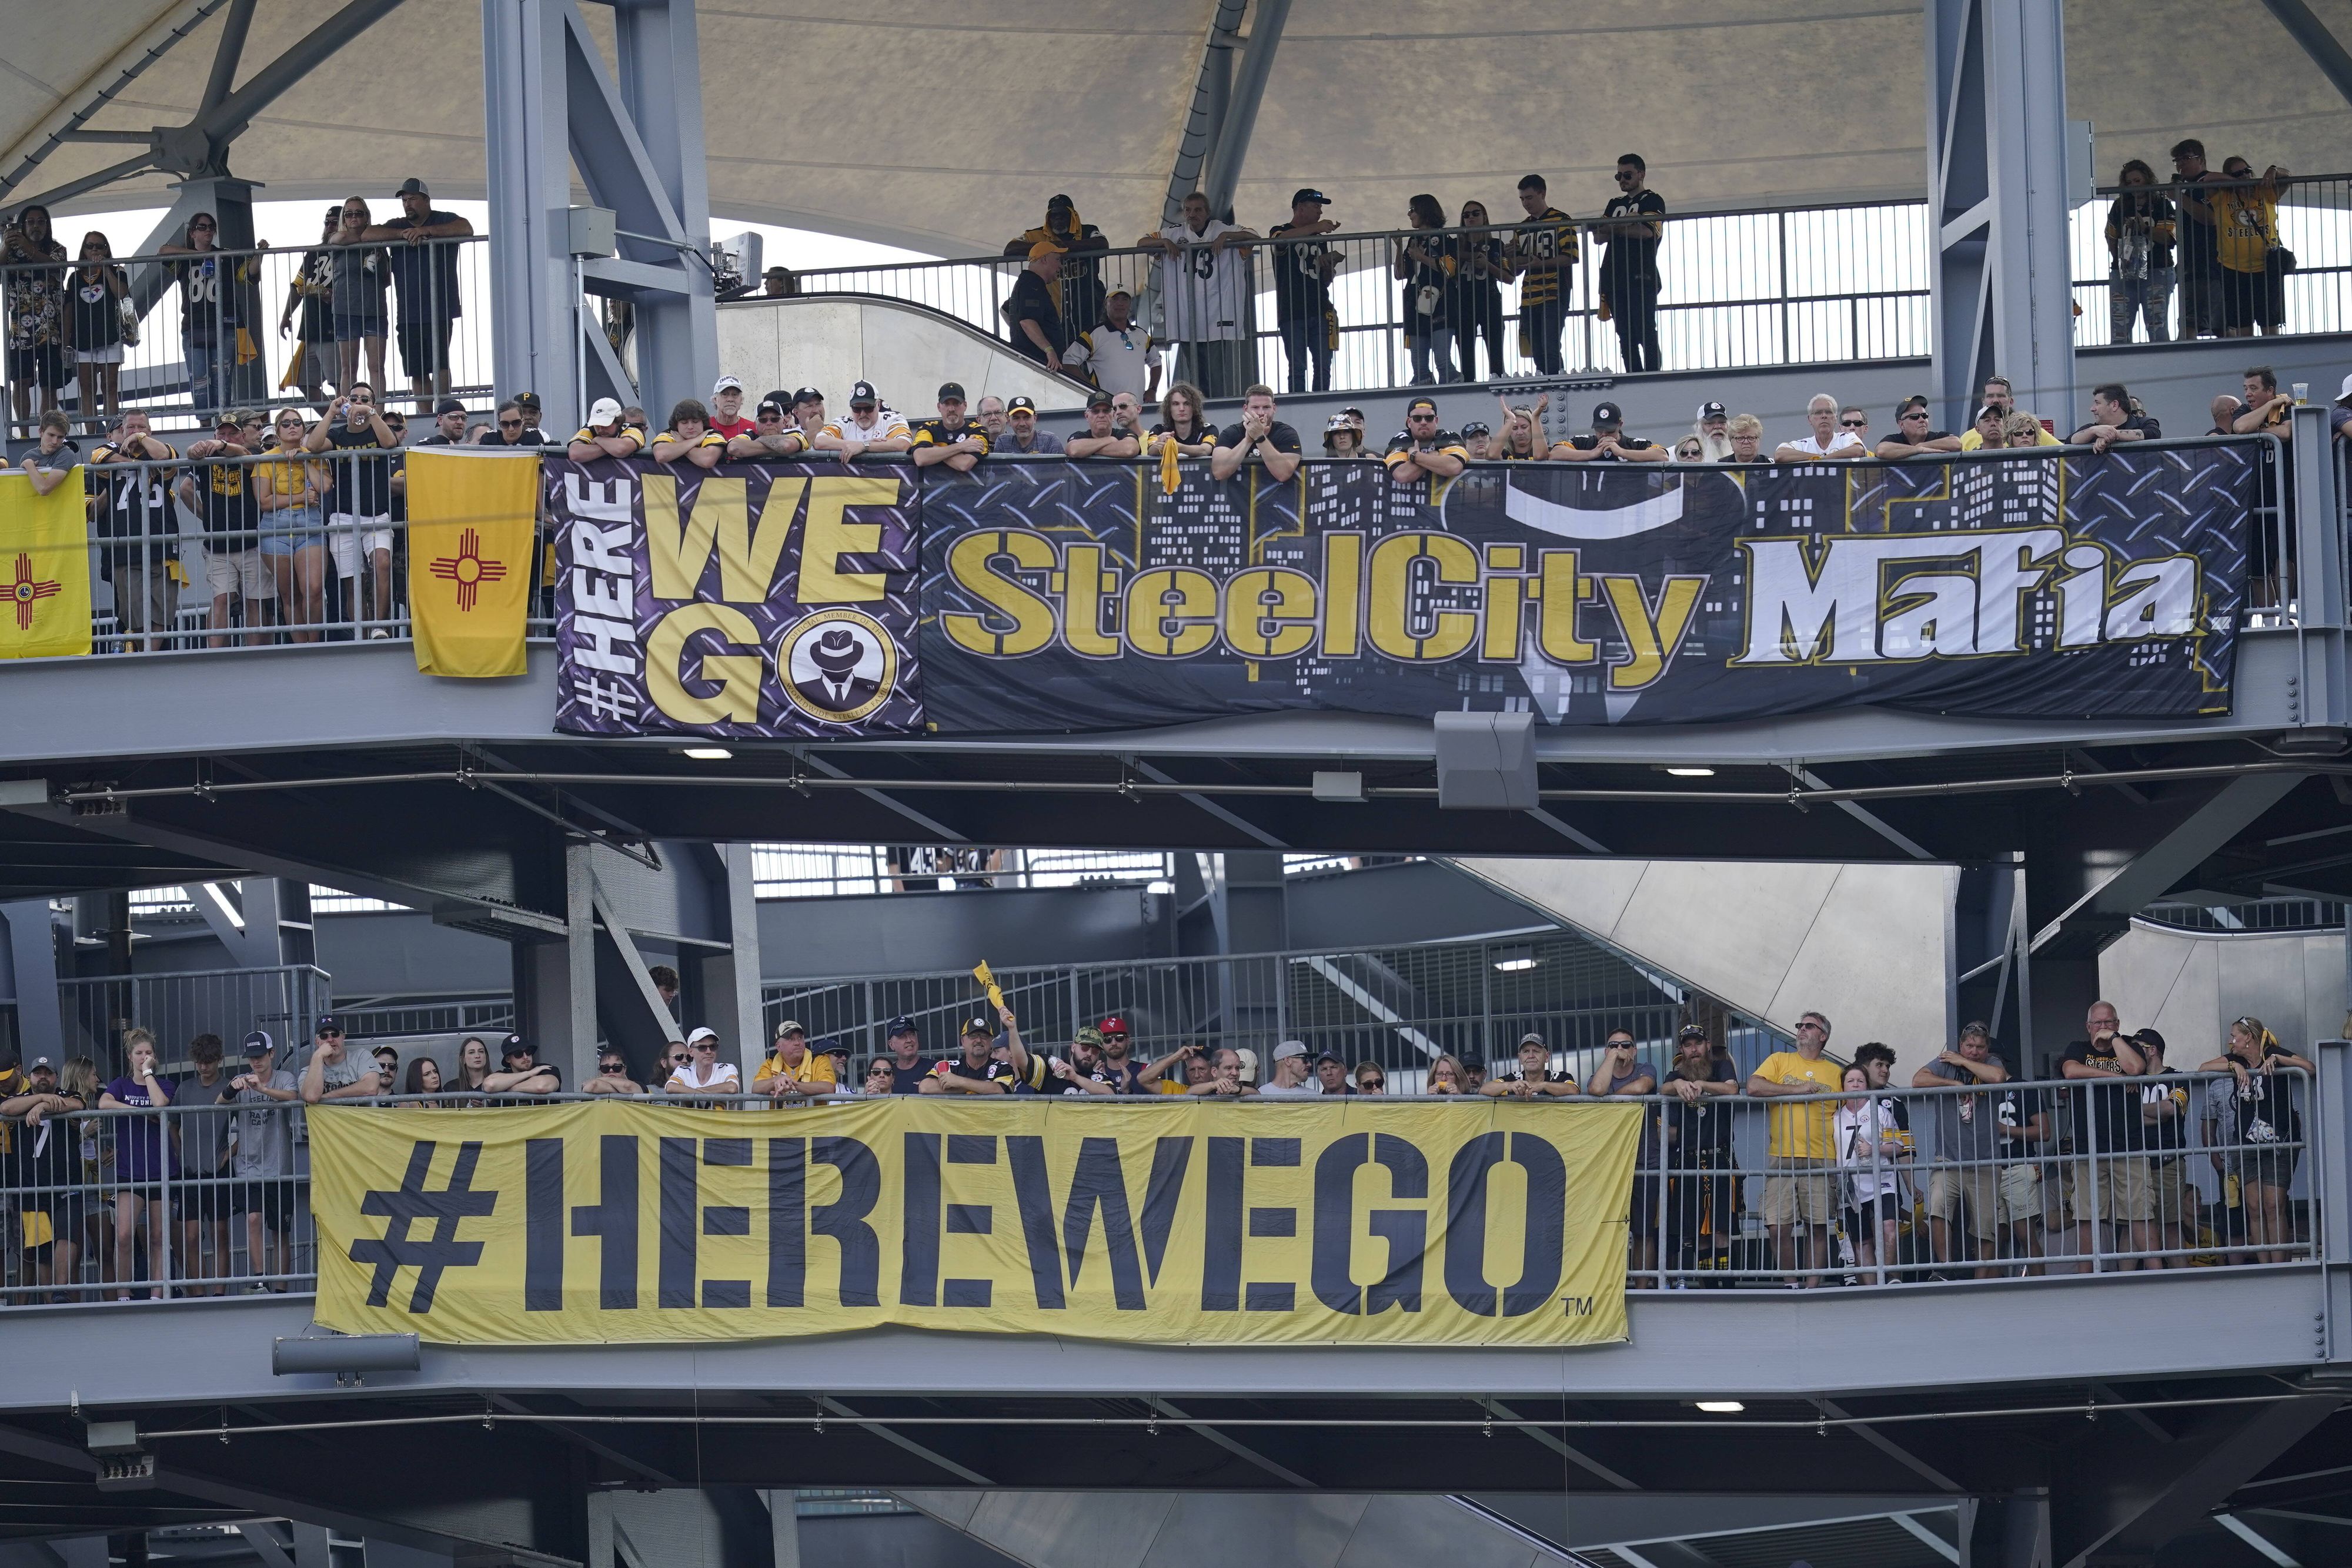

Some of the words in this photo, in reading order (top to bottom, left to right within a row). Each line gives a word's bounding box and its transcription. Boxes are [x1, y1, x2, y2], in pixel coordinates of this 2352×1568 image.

[523, 393, 530, 401] P
[641, 473, 901, 604] WE
[564, 473, 637, 721] #HERE
[1728, 526, 2204, 667] Mafia
[790, 617, 821, 640] OFFICIAL
[824, 612, 857, 620] MEMBER
[860, 617, 870, 626] OF
[871, 624, 886, 640] THE
[786, 683, 829, 718] WORLDWIDE
[833, 707, 869, 720] STEELERS
[871, 680, 891, 707] FAMILY
[32, 1119, 51, 1158] 7
[1845, 1125, 1860, 1159] 7
[349, 1131, 1566, 1318] #HEREWEGO
[1561, 1296, 1594, 1318] TM
